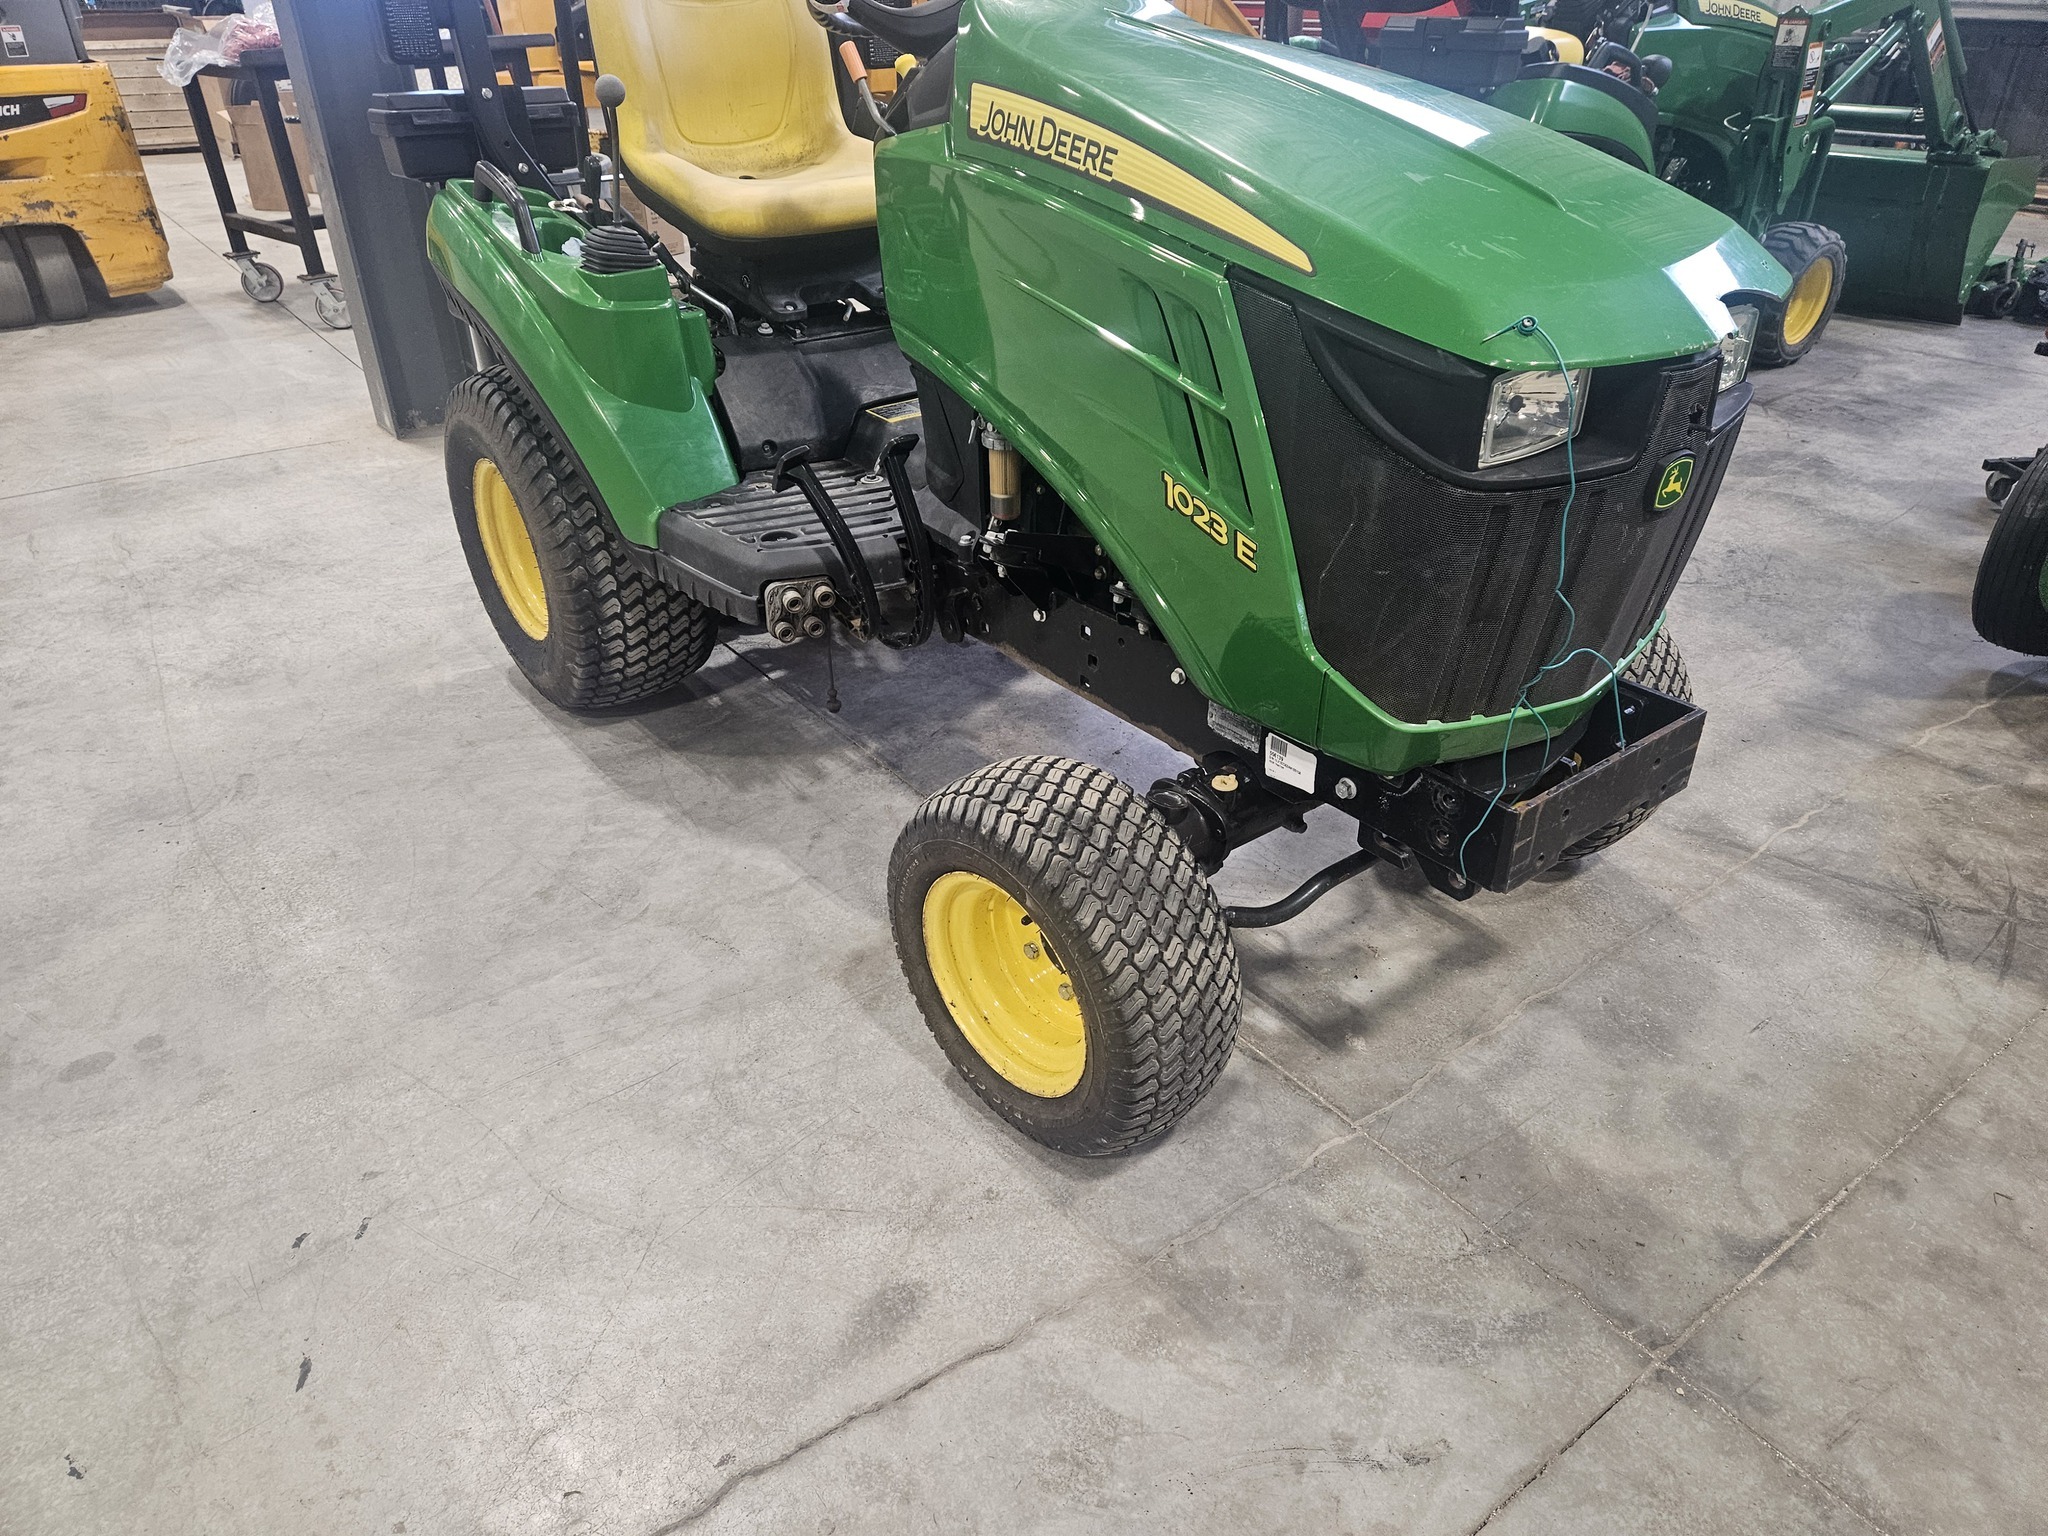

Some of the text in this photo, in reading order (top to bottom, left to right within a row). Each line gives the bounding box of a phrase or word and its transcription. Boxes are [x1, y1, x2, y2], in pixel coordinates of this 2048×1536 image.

[1706, 2, 1762, 22] JOHN DEERE
[980, 101, 1119, 178] JOHN DEERE
[1161, 470, 1258, 573] 1023 E
